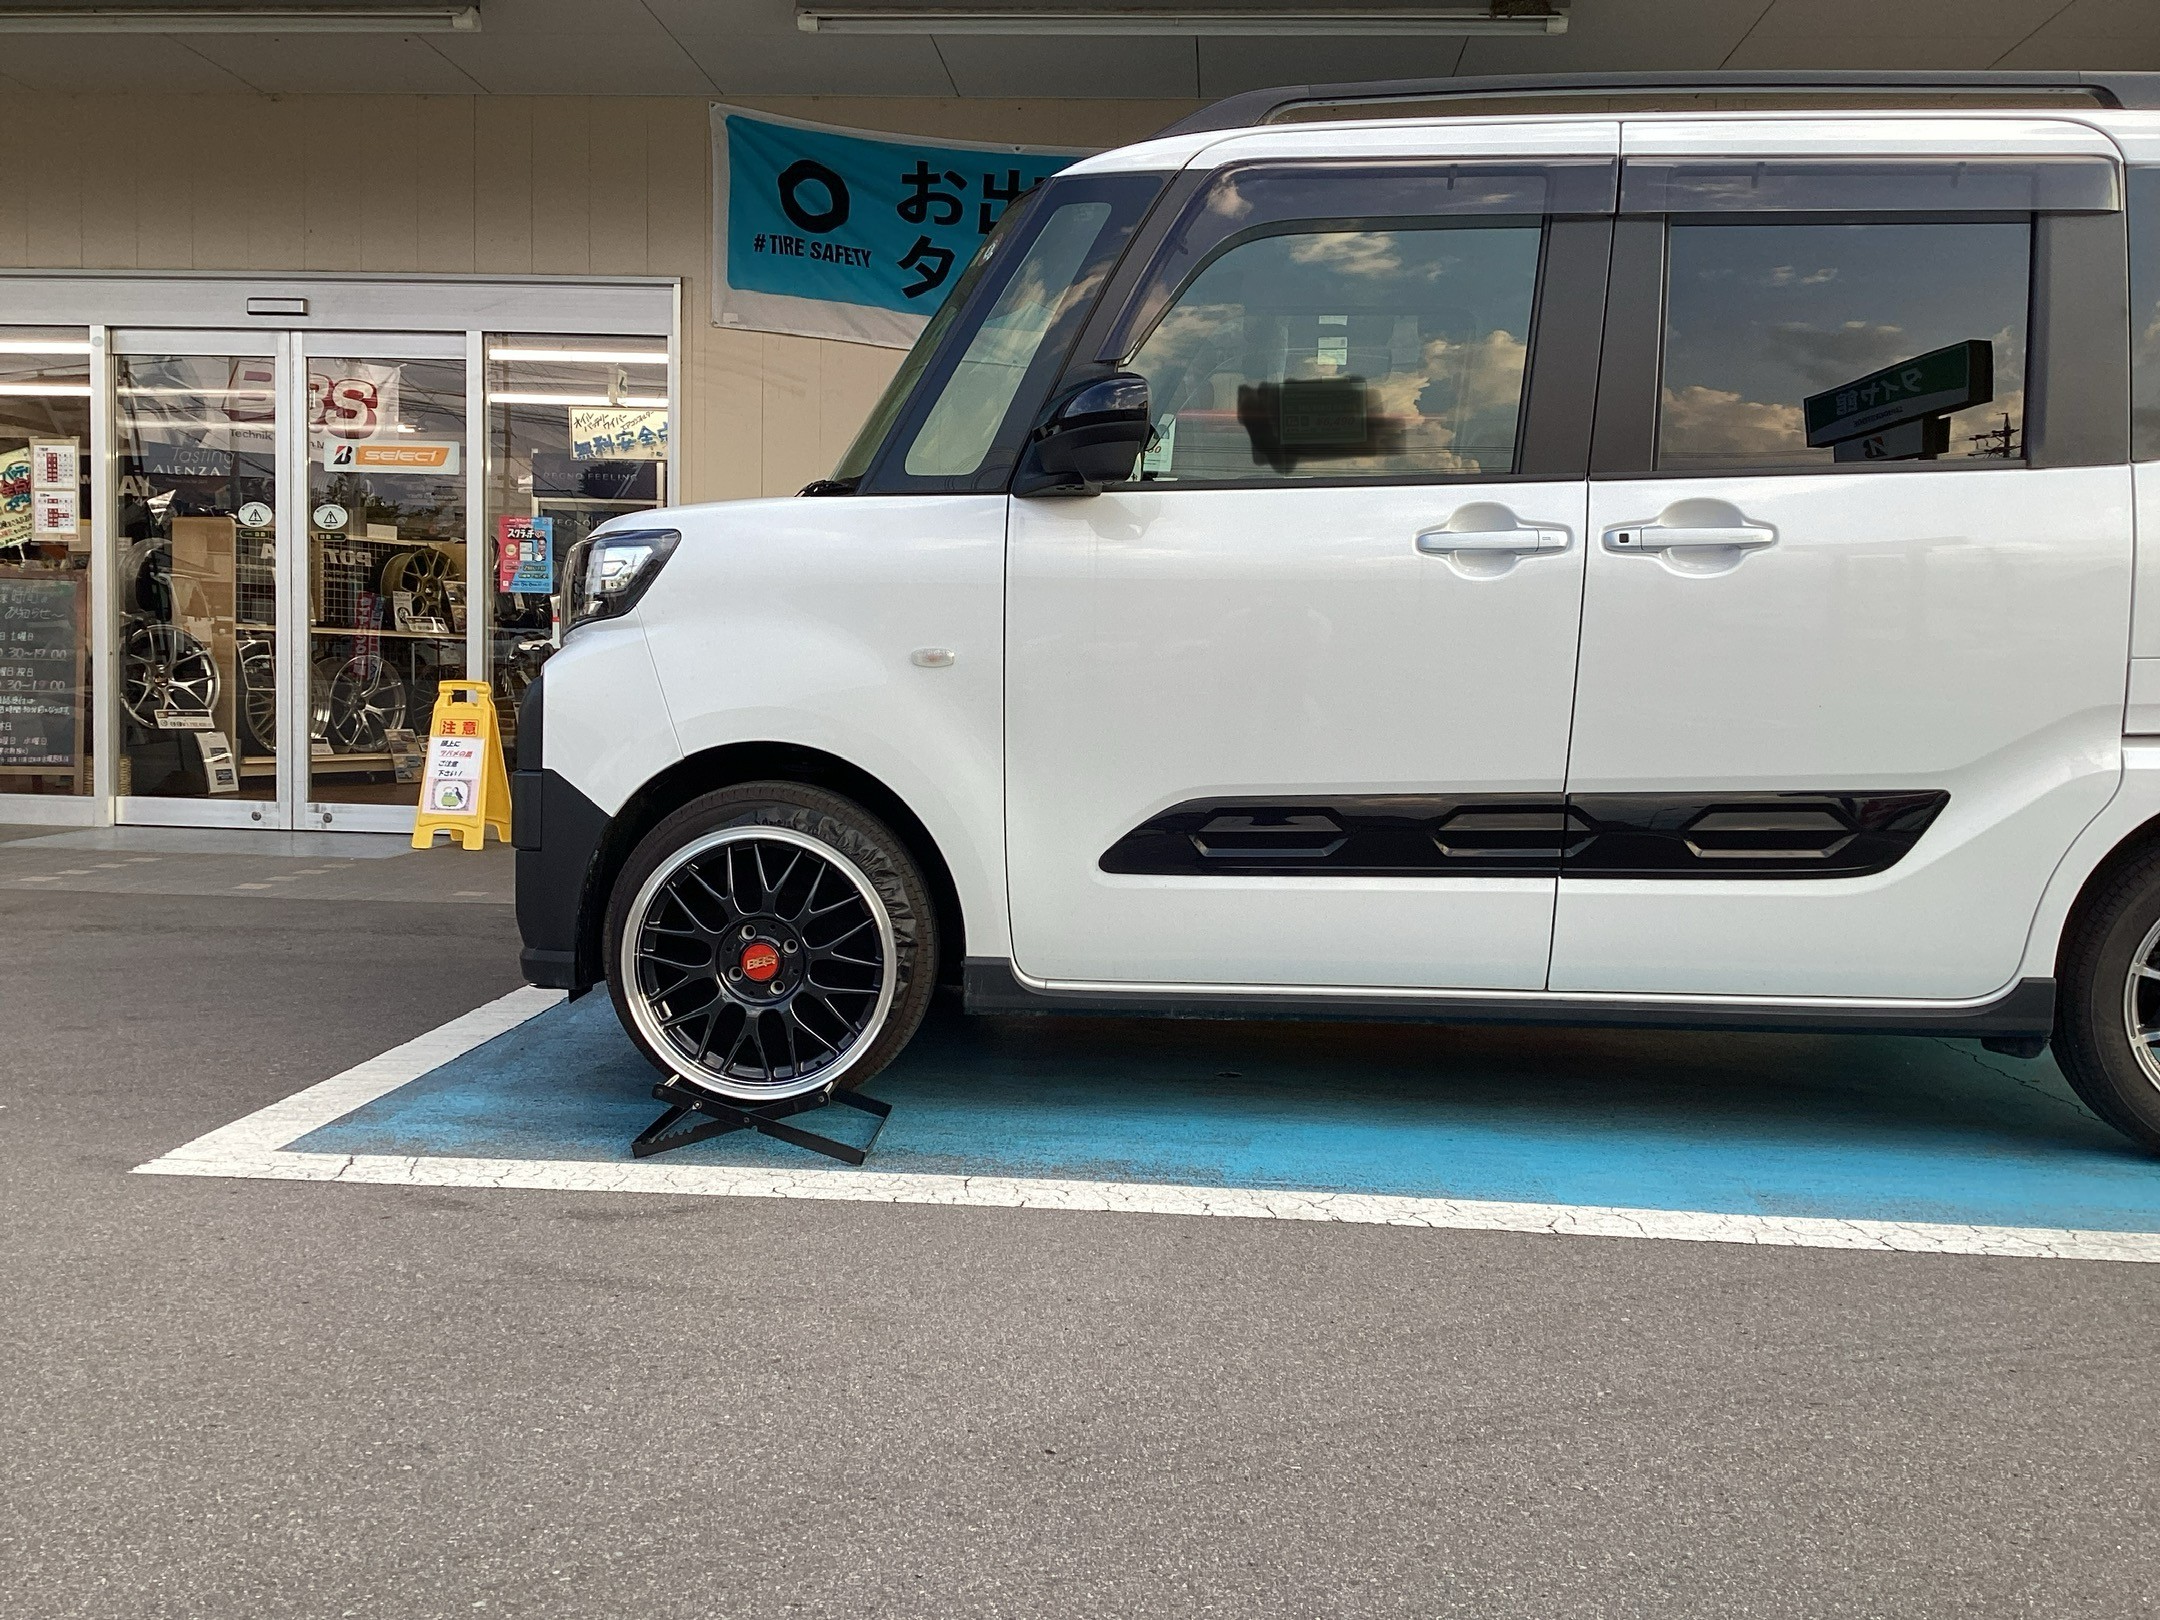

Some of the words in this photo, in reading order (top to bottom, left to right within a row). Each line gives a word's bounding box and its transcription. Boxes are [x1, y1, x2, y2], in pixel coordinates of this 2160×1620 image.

[809, 241, 872, 269] SAFETY
[230, 428, 273, 441] Technik
[171, 446, 235, 469] Tasting
[153, 464, 221, 476] ALENZA
[441, 720, 477, 735] 注意
[438, 760, 459, 768] ご注意
[746, 954, 776, 970] BBS
